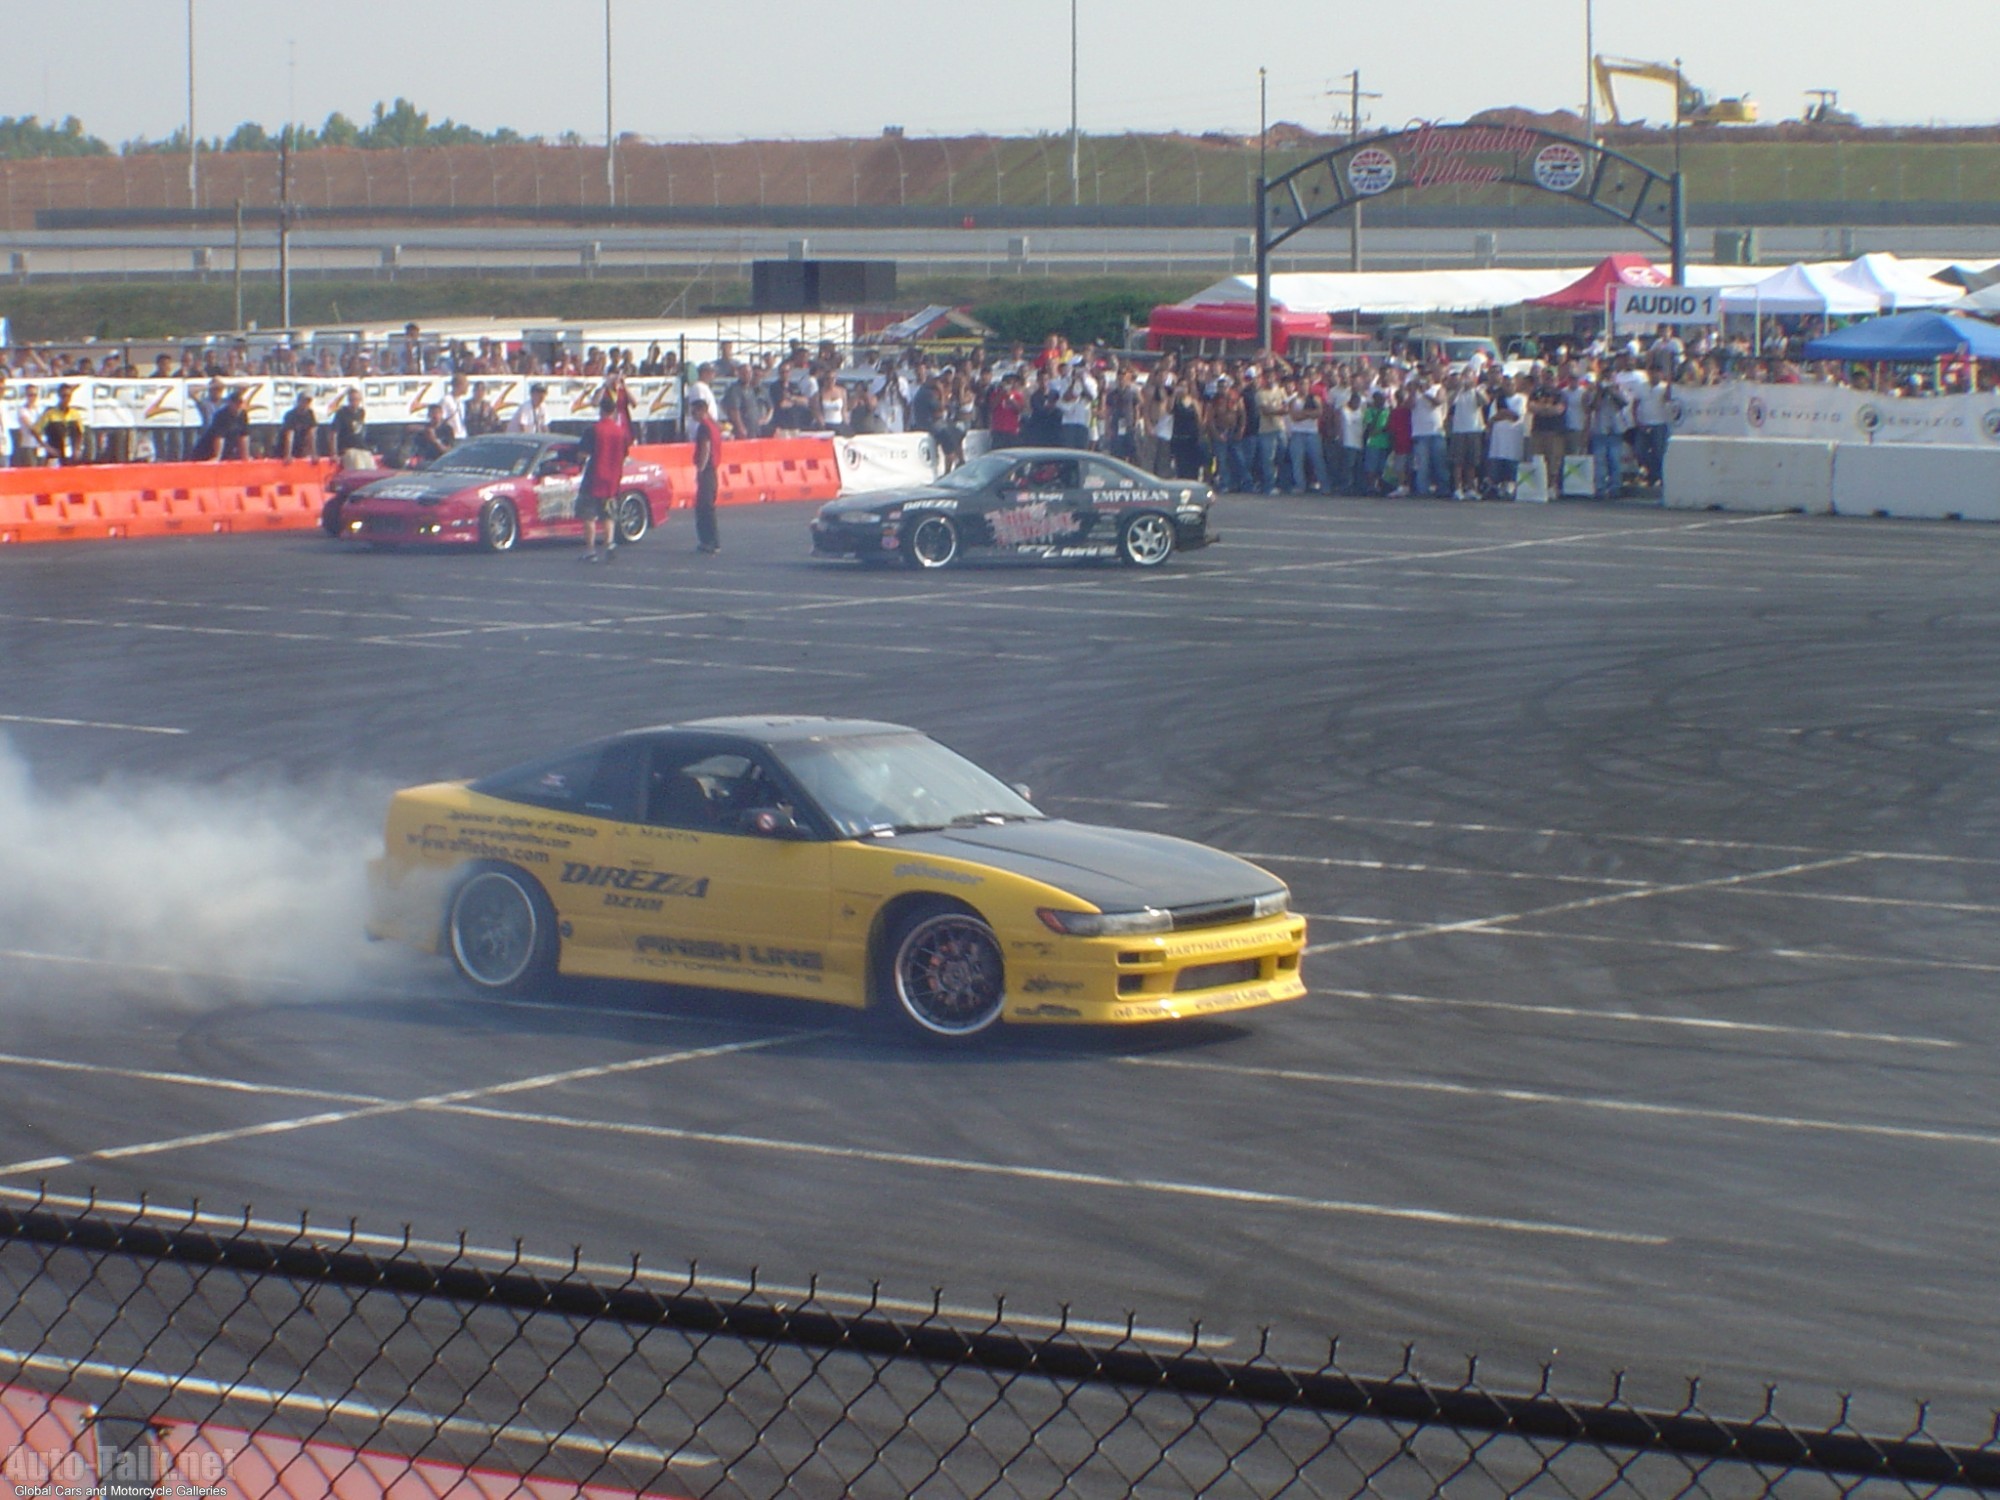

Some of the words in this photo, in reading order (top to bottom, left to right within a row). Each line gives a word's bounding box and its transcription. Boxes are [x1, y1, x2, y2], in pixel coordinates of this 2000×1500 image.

[1397, 117, 1539, 160] Hospitality
[1410, 155, 1502, 194] Village
[1625, 295, 1697, 315] AUDIO
[1702, 295, 1713, 315] 1
[1769, 409, 1842, 424] ENVIZIO
[560, 860, 710, 898] DIREZZA
[747, 945, 824, 971] LINE
